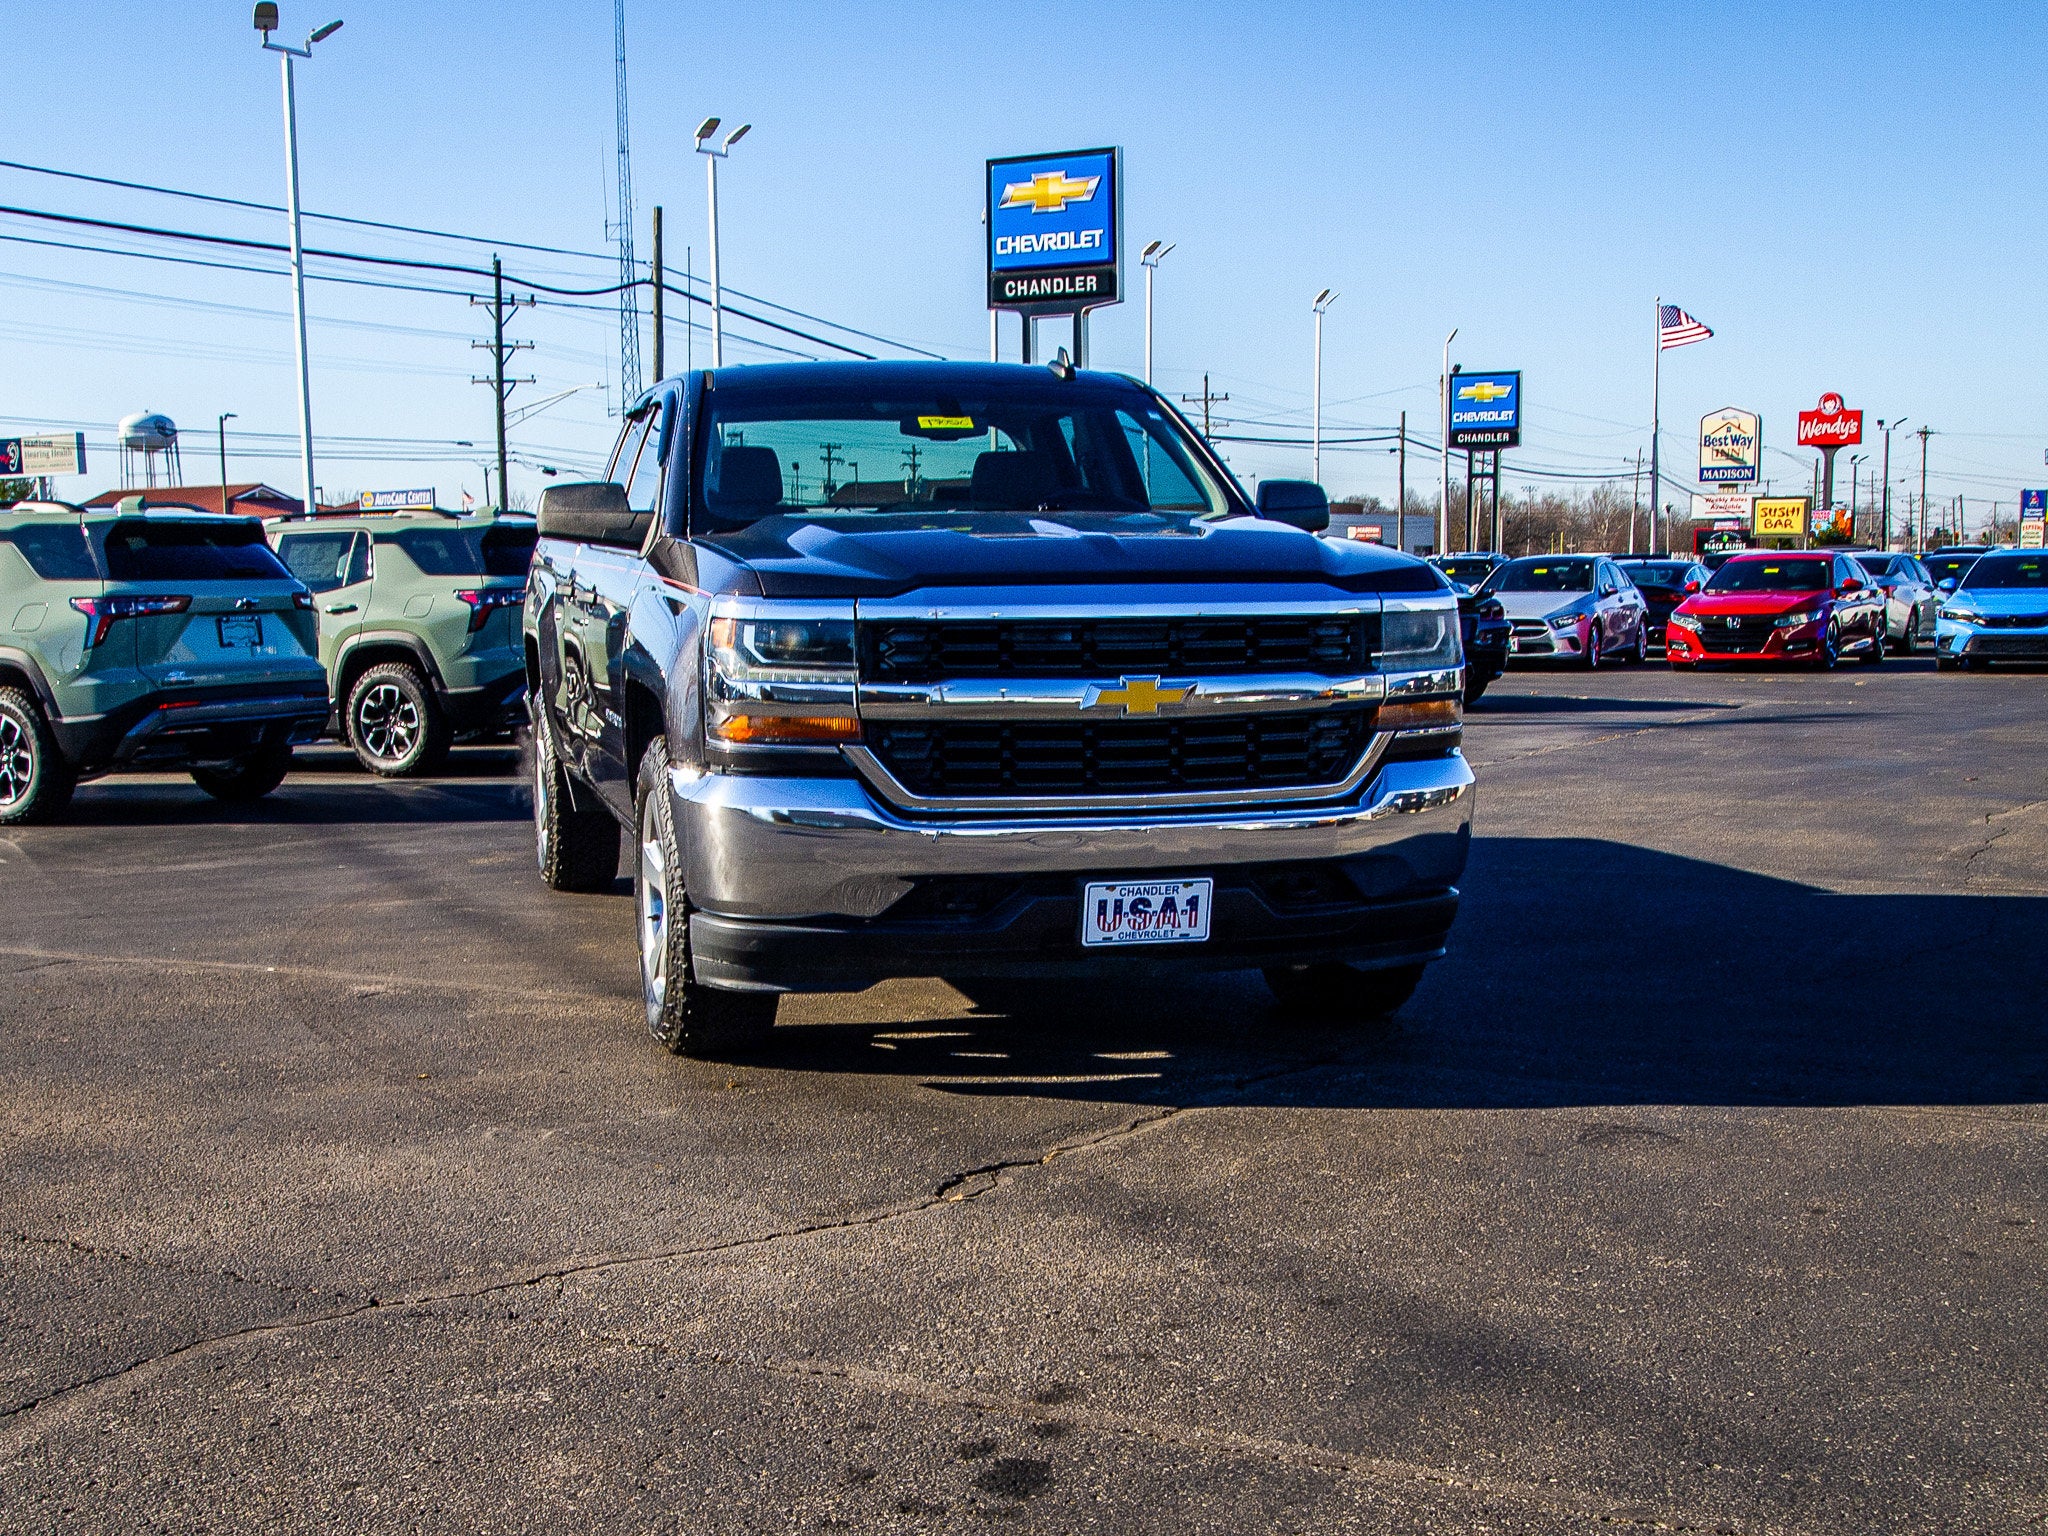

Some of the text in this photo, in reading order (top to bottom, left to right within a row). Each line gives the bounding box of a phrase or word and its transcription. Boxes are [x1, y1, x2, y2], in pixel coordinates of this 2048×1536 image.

[996, 229, 1103, 255] CHEVROLET
[1005, 275, 1097, 297] CHANDLER
[1453, 410, 1514, 422] CHEVROLET
[1800, 415, 1858, 441] Wendy's
[1457, 432, 1509, 443] CHANDLER
[1704, 434, 1754, 450] Best Way
[1702, 468, 1753, 480] MADISON
[1760, 506, 1800, 518] SUSHI
[1763, 518, 1794, 530] BAR
[1119, 885, 1180, 897] CHANDLER
[1118, 929, 1175, 940] CHEVROLET
